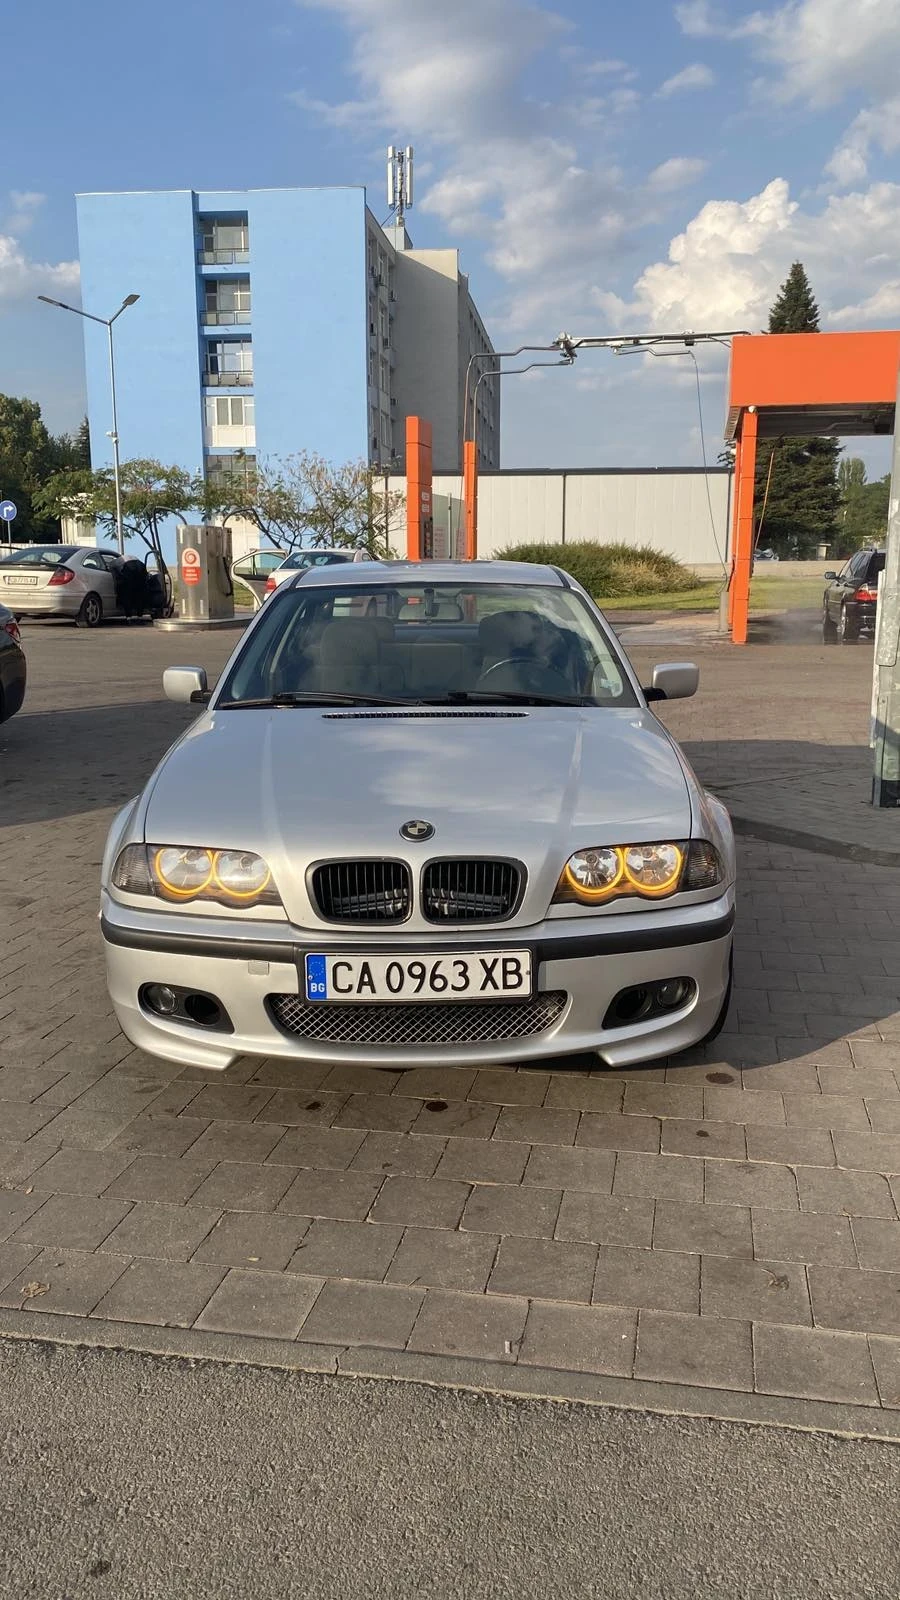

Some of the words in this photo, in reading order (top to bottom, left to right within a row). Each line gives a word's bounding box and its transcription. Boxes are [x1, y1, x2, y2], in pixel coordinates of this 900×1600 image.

[310, 982, 326, 993] BG
[332, 961, 377, 994] CA
[385, 960, 470, 993] 0963
[479, 957, 523, 991] XB
